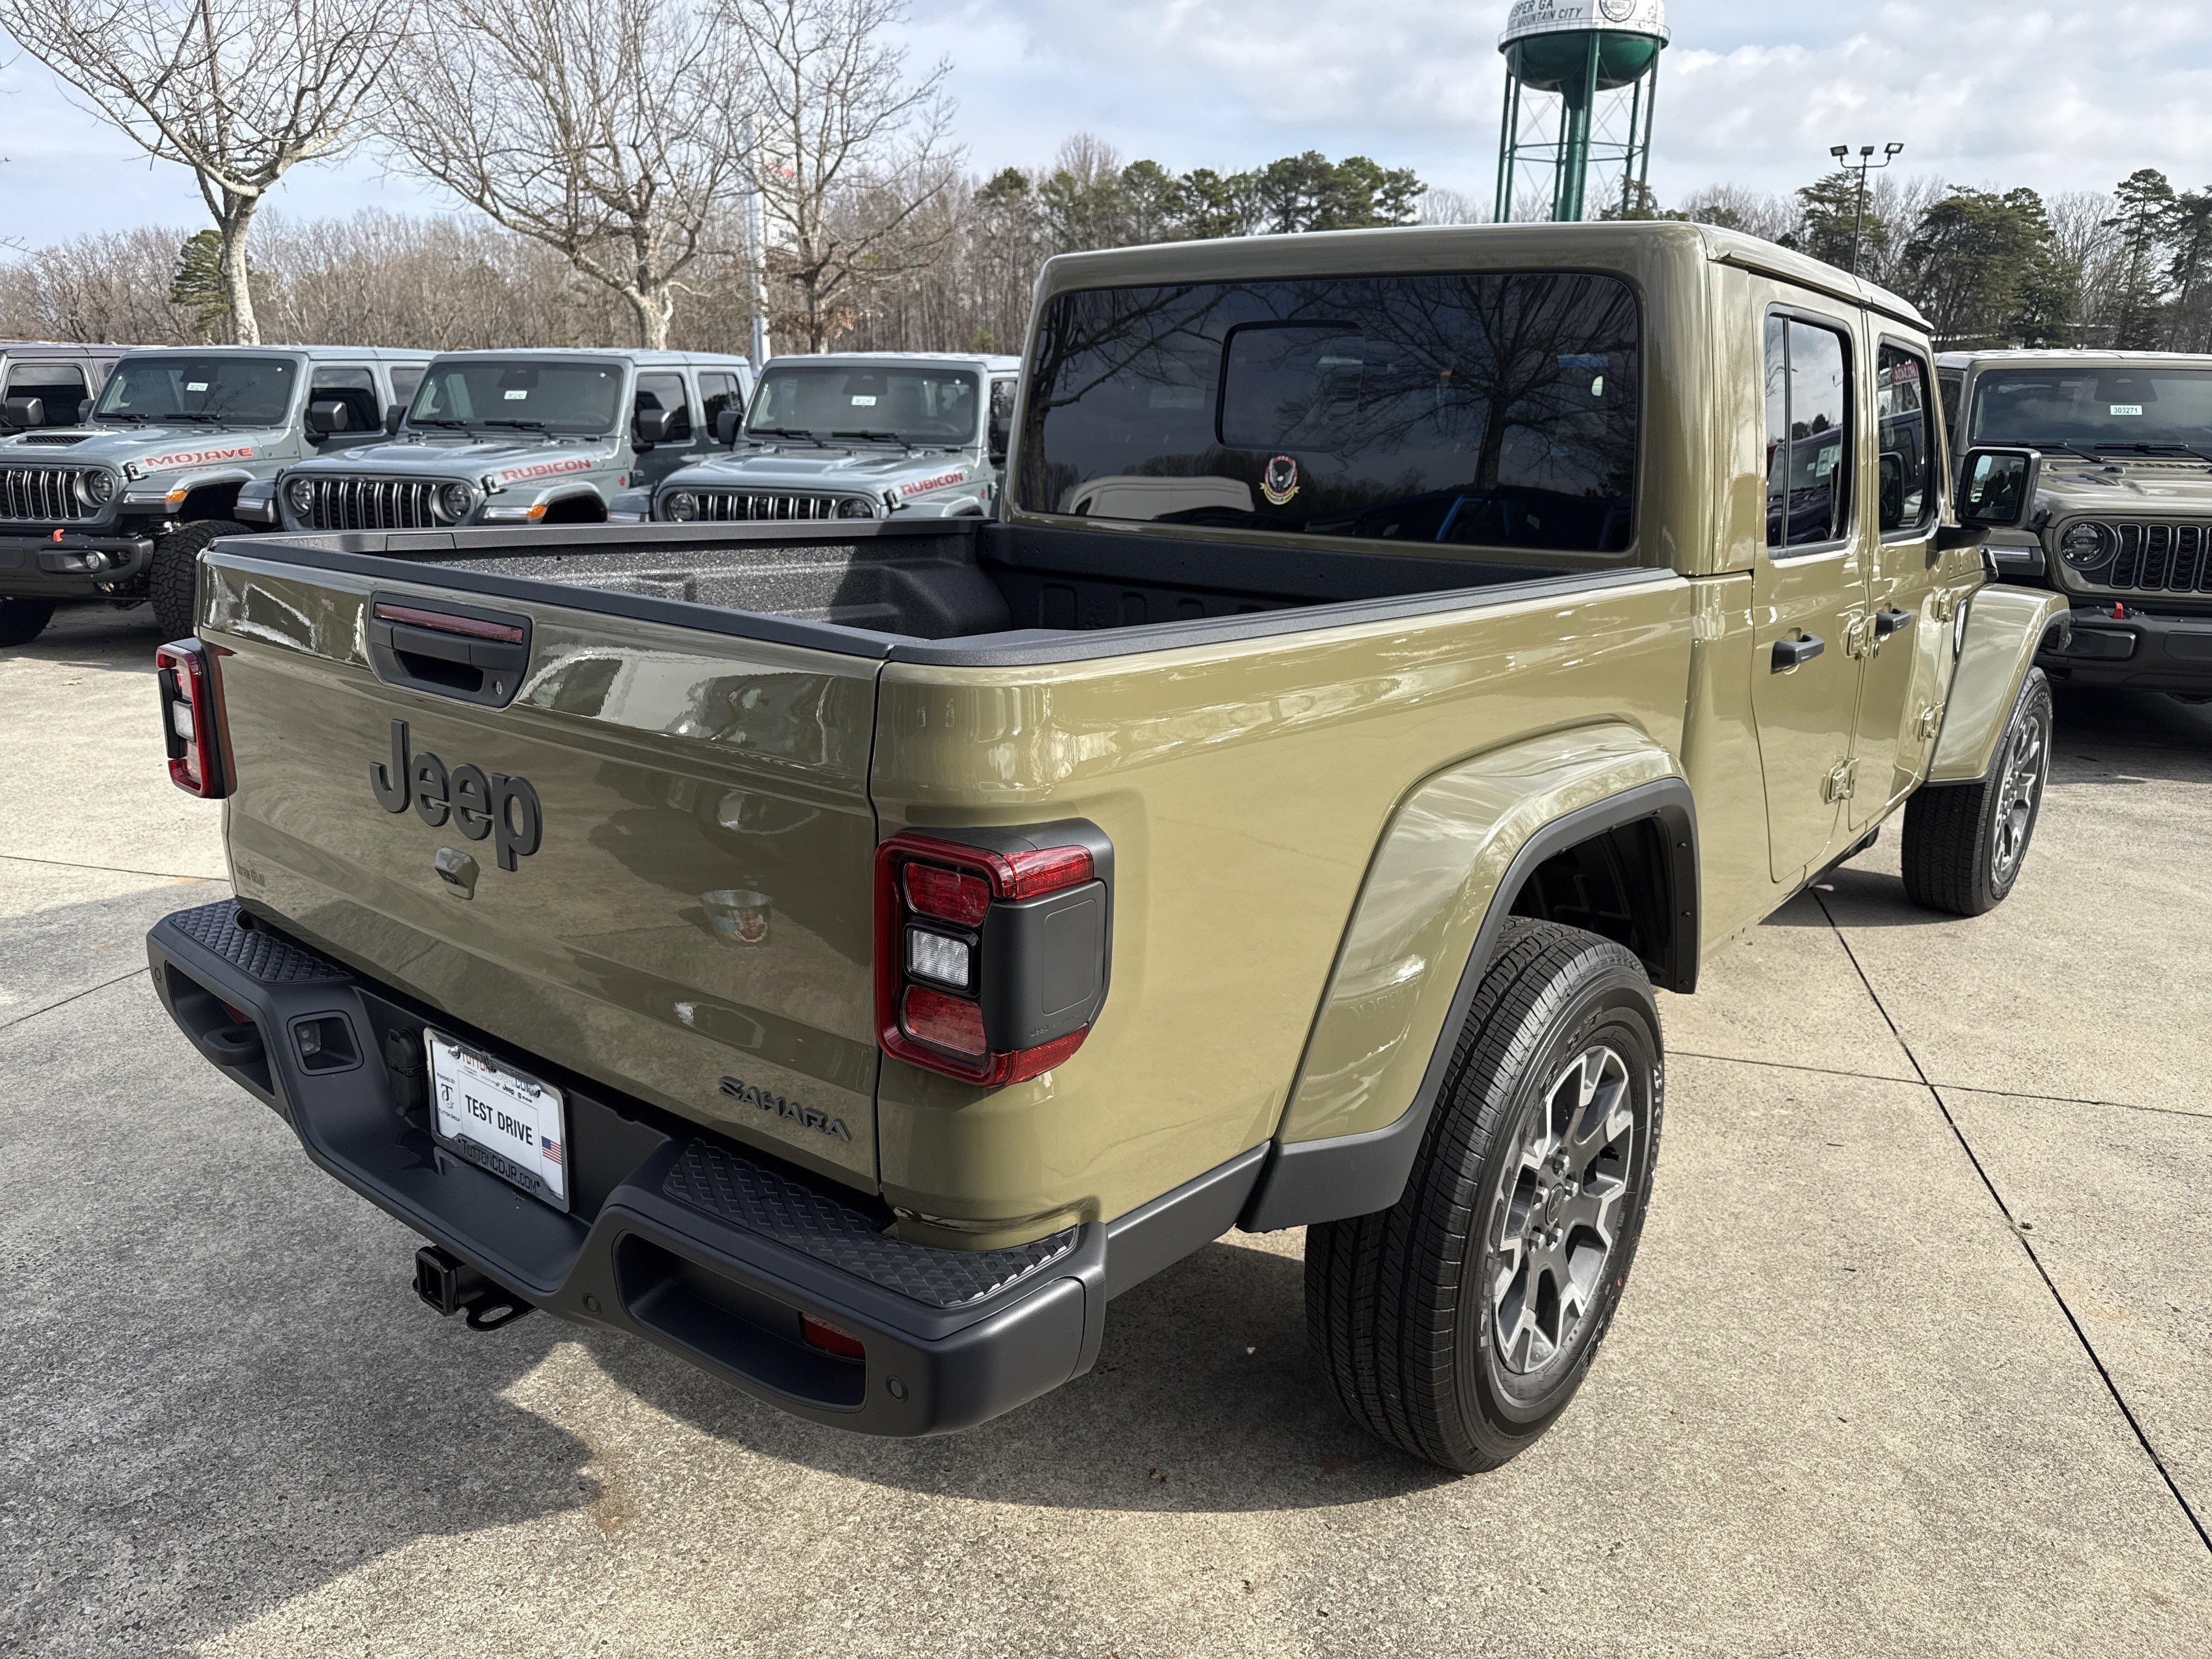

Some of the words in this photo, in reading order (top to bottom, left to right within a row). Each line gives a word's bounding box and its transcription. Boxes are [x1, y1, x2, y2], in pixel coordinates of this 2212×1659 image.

[1558, 7, 1583, 19] CITY
[144, 447, 254, 468] MOJAVE
[500, 459, 592, 481] RUBICON
[900, 472, 964, 495] RUBICON
[370, 719, 543, 871] Jeep
[503, 1084, 515, 1095] Jeep
[465, 1094, 493, 1124] TEST
[498, 1111, 533, 1146] DRIVE
[719, 1075, 852, 1142] SAHARA
[461, 1139, 537, 1193] TUTTONCDJR.COM
